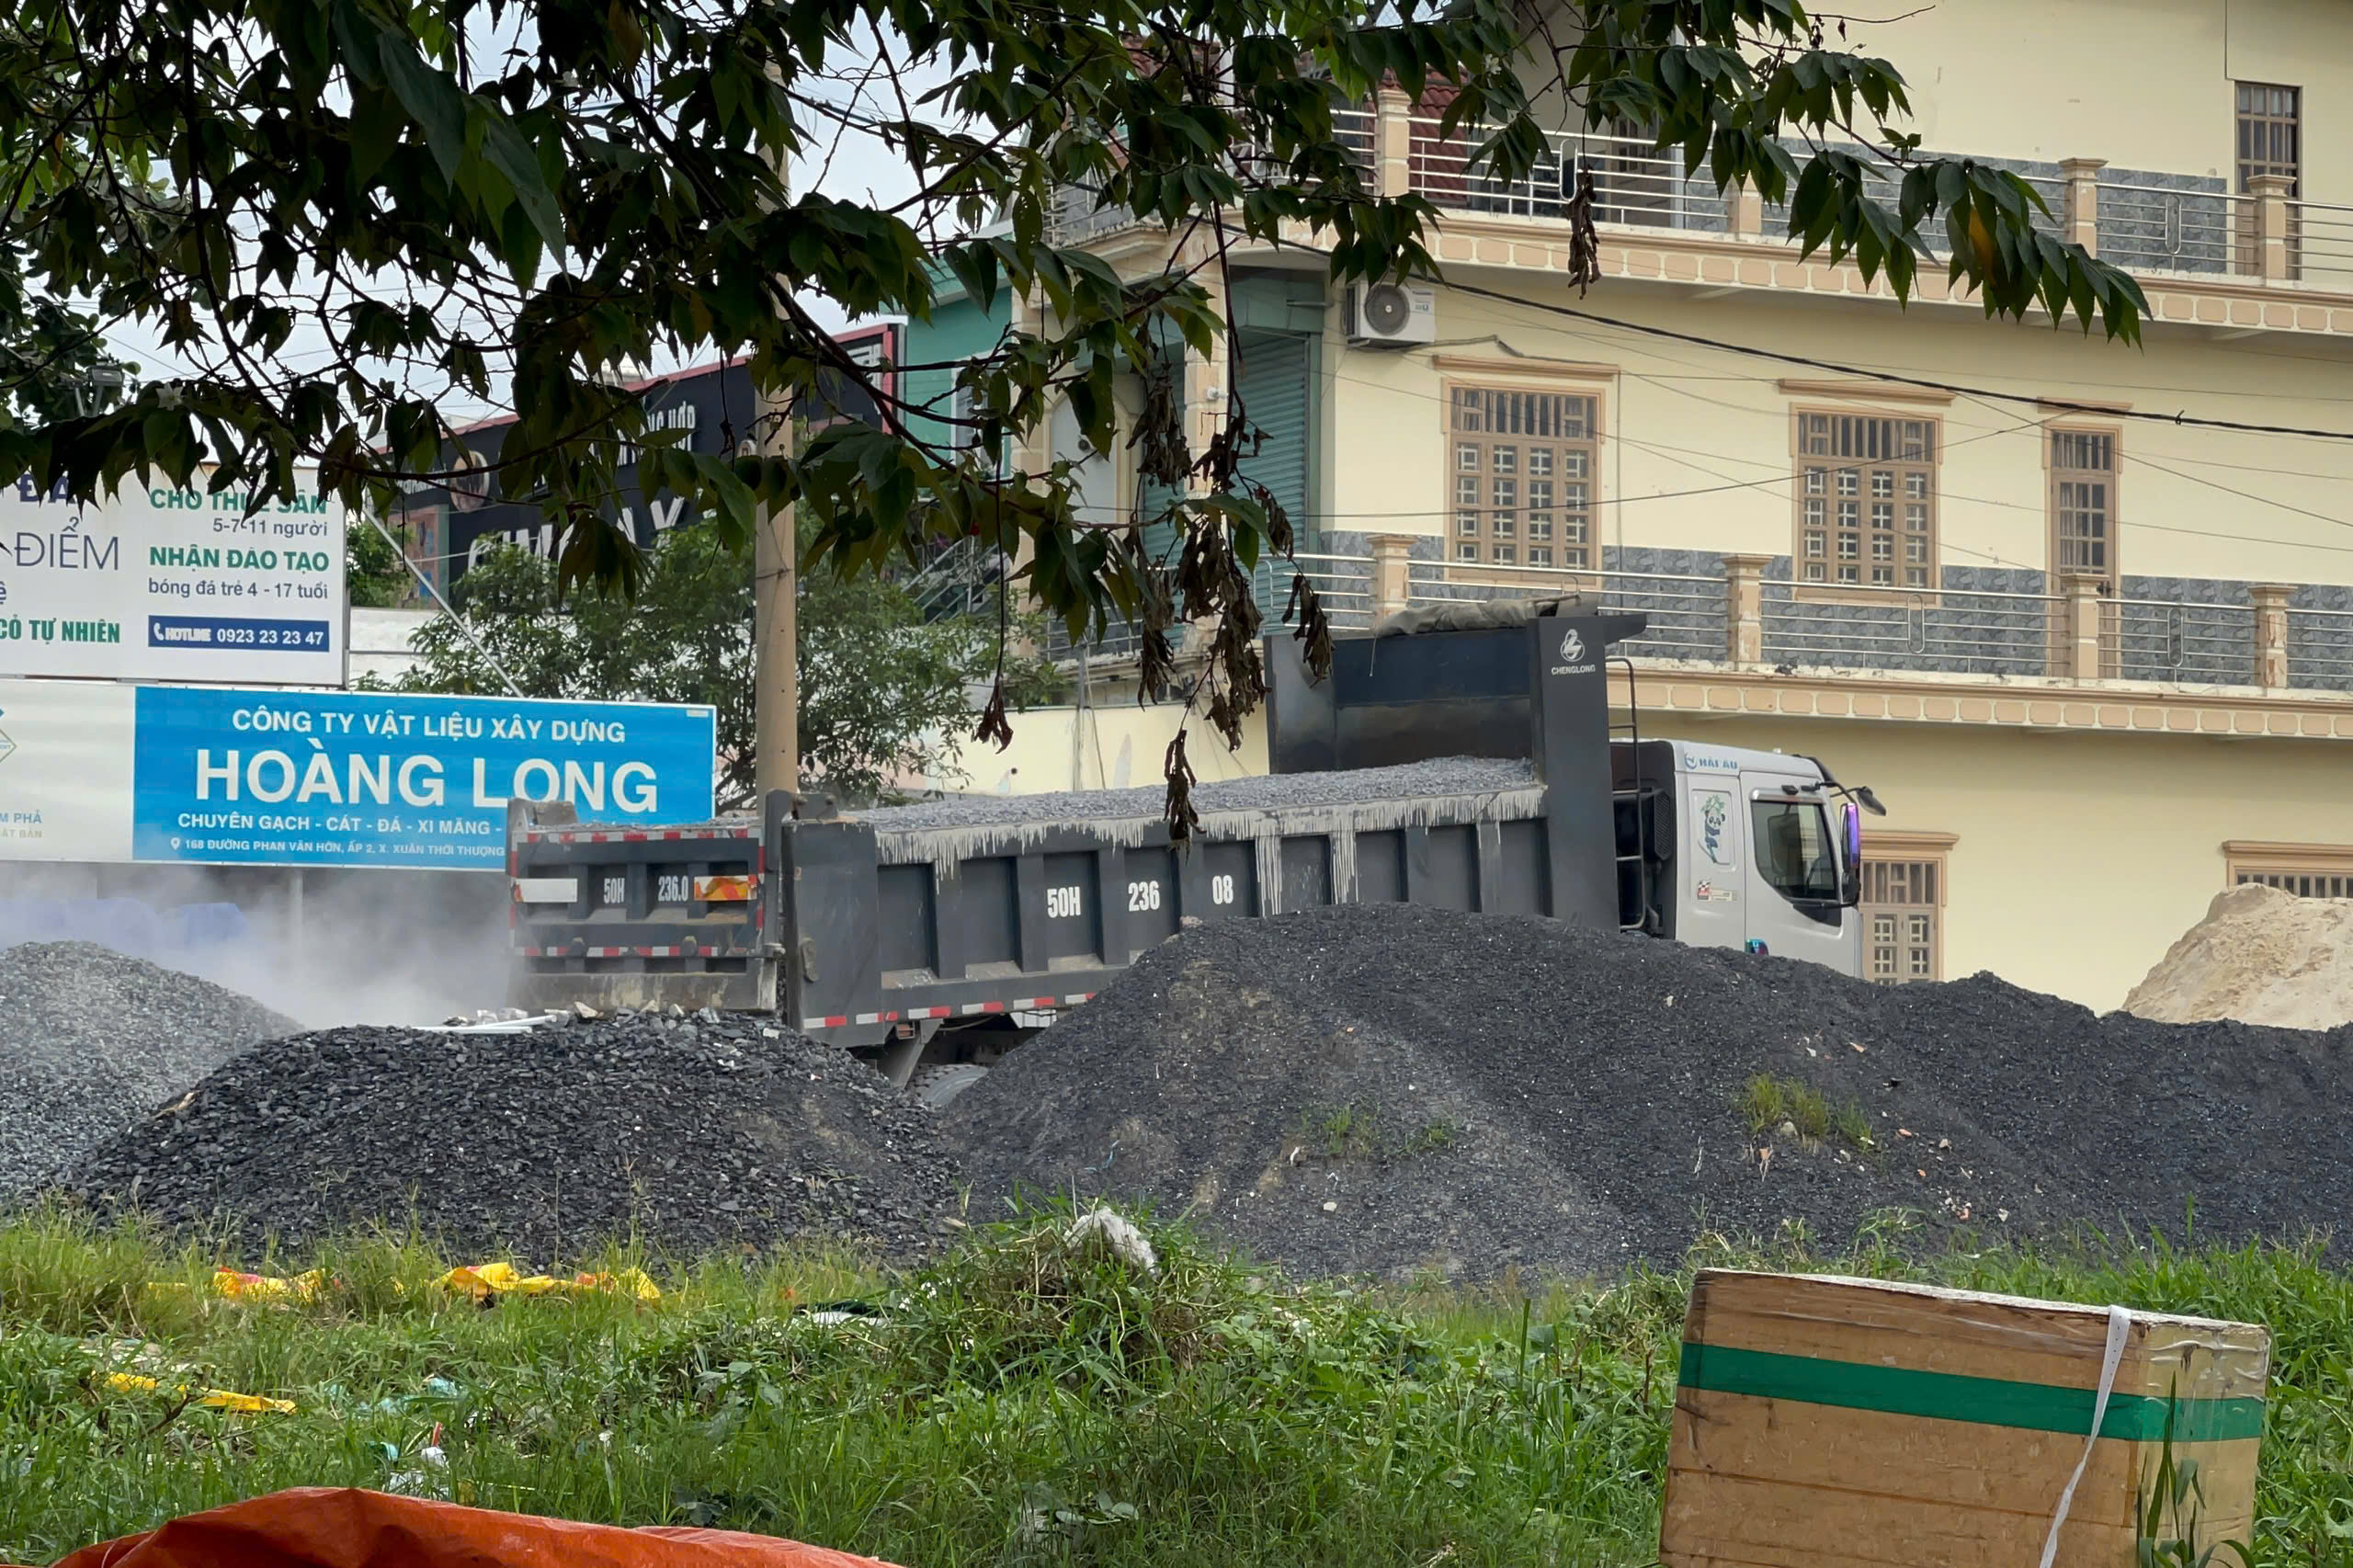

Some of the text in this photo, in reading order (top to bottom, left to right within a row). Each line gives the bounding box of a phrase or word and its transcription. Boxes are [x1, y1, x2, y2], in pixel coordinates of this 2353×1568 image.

[150, 489, 202, 510] CHO
[213, 518, 327, 538] 5-7-11 người
[15, 517, 119, 571] ĐIỂM
[150, 544, 329, 574] NHẬN ĐÀO TẠO
[149, 577, 190, 597] bóng
[196, 580, 216, 596] đá
[222, 580, 243, 597] trẻ
[247, 583, 257, 597] 4
[277, 584, 292, 597] 17
[298, 582, 328, 598] tuổi
[28, 618, 57, 645] TỰ
[62, 619, 120, 643] NHIÊN
[165, 628, 324, 645] HOTLINE 0923 23 23 47
[1551, 664, 1597, 676] CHENGLONG
[232, 704, 626, 745] CÔNG TY VẬT LIỆU XÂY DỰNG
[196, 738, 658, 813] HOÀNG LONG
[177, 811, 253, 829] CHUYÊN
[258, 815, 310, 833] GẠCH
[326, 814, 362, 832] CÁT
[377, 815, 402, 833] ĐÁ
[418, 820, 433, 834] XI
[438, 817, 490, 835] MĂNG
[185, 840, 204, 850] 168
[207, 838, 250, 851] ĐƯỜNG
[253, 841, 286, 851] PHAN
[289, 839, 313, 852] VĂN
[393, 843, 425, 855] XUÂN
[603, 875, 689, 903] 50H 236.0
[1047, 874, 1233, 918] 50H 236 08
